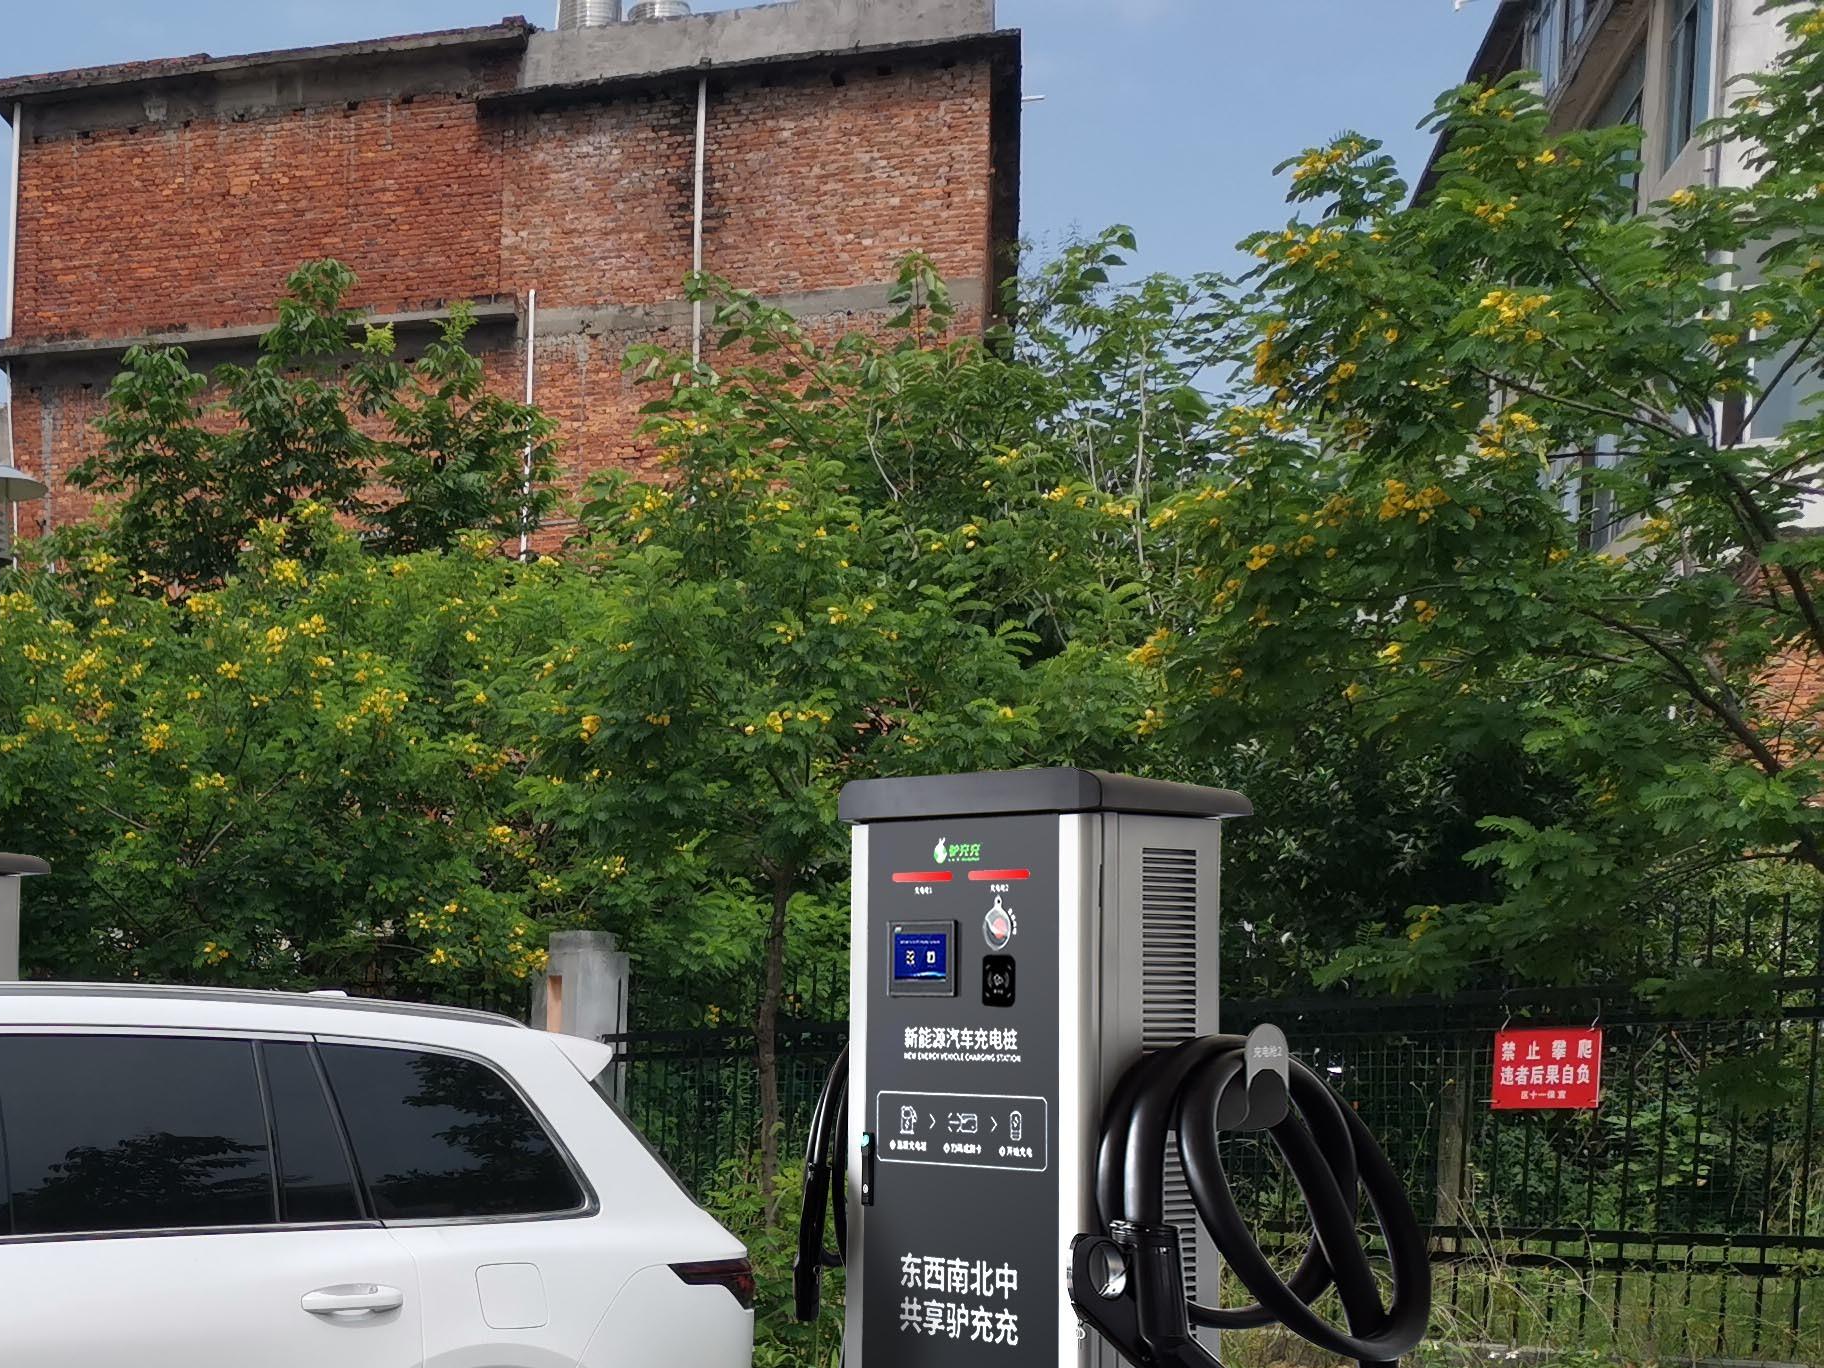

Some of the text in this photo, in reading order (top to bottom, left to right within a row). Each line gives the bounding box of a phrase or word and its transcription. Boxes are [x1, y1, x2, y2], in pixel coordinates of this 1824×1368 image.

[904, 1026, 1018, 1050] 新能源汽车充电桩
[1501, 1039, 1593, 1061] 禁止攀爬
[1500, 1063, 1590, 1086] 违者后果自负
[900, 1252, 1018, 1300] 东西南北中
[900, 1296, 1019, 1346] 共享驴充充
